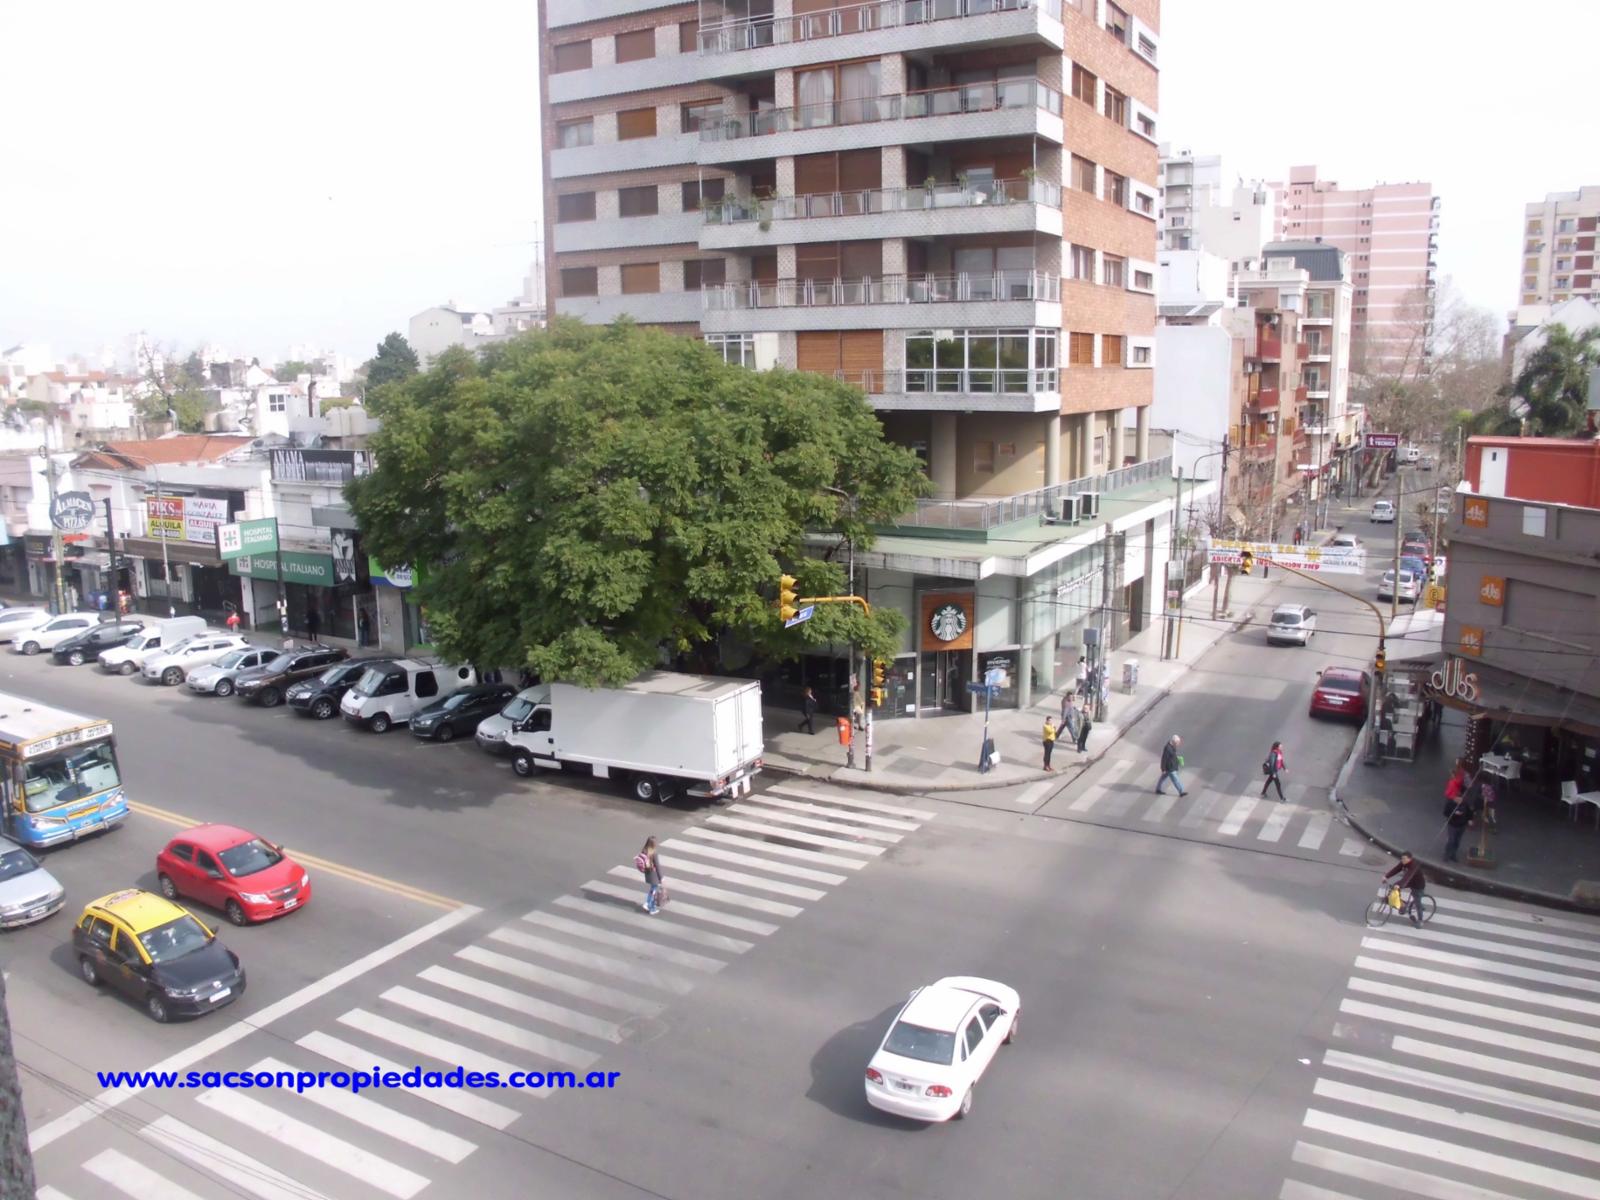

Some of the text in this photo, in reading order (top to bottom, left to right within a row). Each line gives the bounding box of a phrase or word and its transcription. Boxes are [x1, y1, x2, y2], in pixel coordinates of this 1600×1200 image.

[151, 519, 181, 530] ALQUILA
[244, 527, 273, 536] HOSPITAL
[244, 534, 273, 544] ITALIANO
[254, 559, 288, 572] HOSPIAL
[290, 563, 325, 576] ITALIANO
[56, 733, 81, 745] 242
